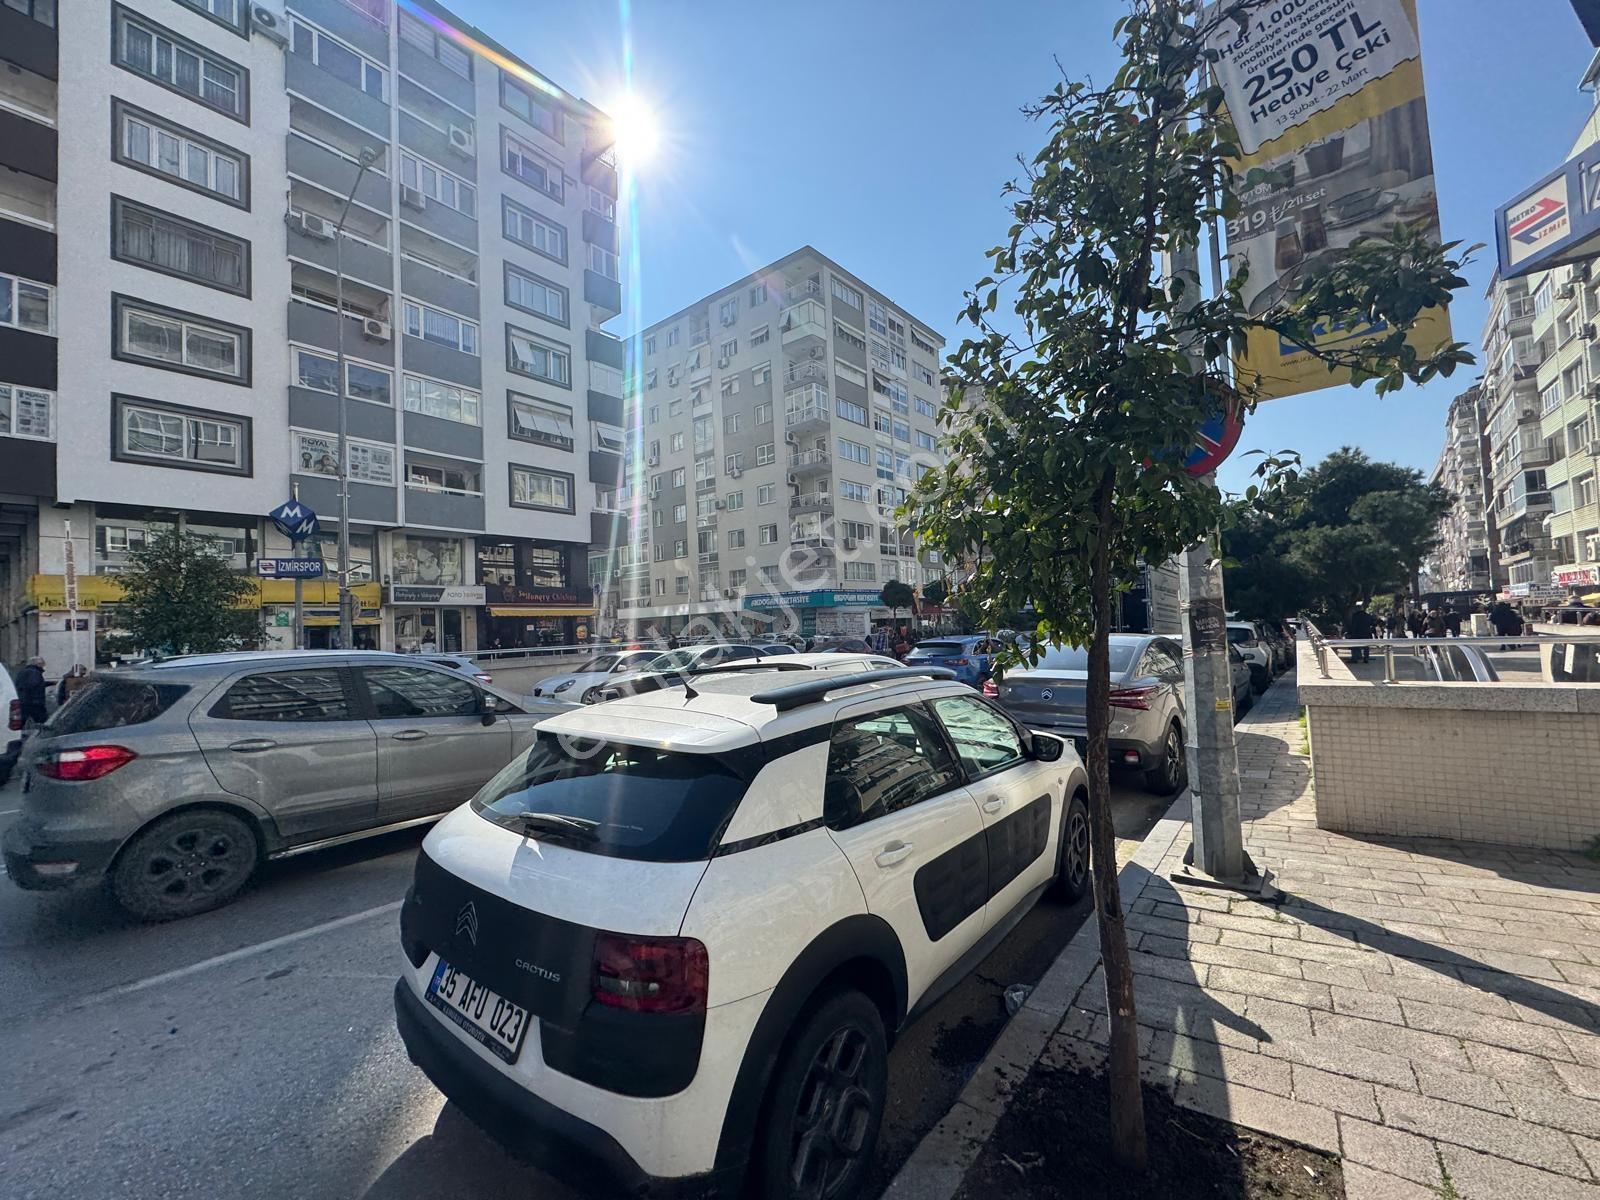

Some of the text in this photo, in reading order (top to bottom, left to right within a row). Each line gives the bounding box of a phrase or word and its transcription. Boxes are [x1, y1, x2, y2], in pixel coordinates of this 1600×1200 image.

[1219, 31, 1251, 60] Her
[1232, 27, 1282, 64] züccaciye
[1240, 0, 1344, 70] mobilya ve aksesu
[1247, 0, 1355, 74] ürünlerinde geçerli
[1243, 11, 1382, 107] 250 TL
[1250, 28, 1392, 125] Hediye Çeki
[1275, 112, 1288, 126] 13
[1289, 97, 1320, 120] Şubat
[1326, 83, 1339, 97] 22
[1342, 67, 1369, 89] Mart
[1226, 210, 1267, 238] 319
[1305, 188, 1327, 202] set
[1510, 205, 1536, 225] METRO
[301, 437, 329, 449] ROYAL
[281, 505, 302, 518] M
[278, 560, 321, 572] İZMİRSPOR
[515, 958, 561, 983] CACTUS
[440, 963, 460, 999] 35
[458, 979, 489, 1021] AFU
[490, 998, 524, 1044] 023
